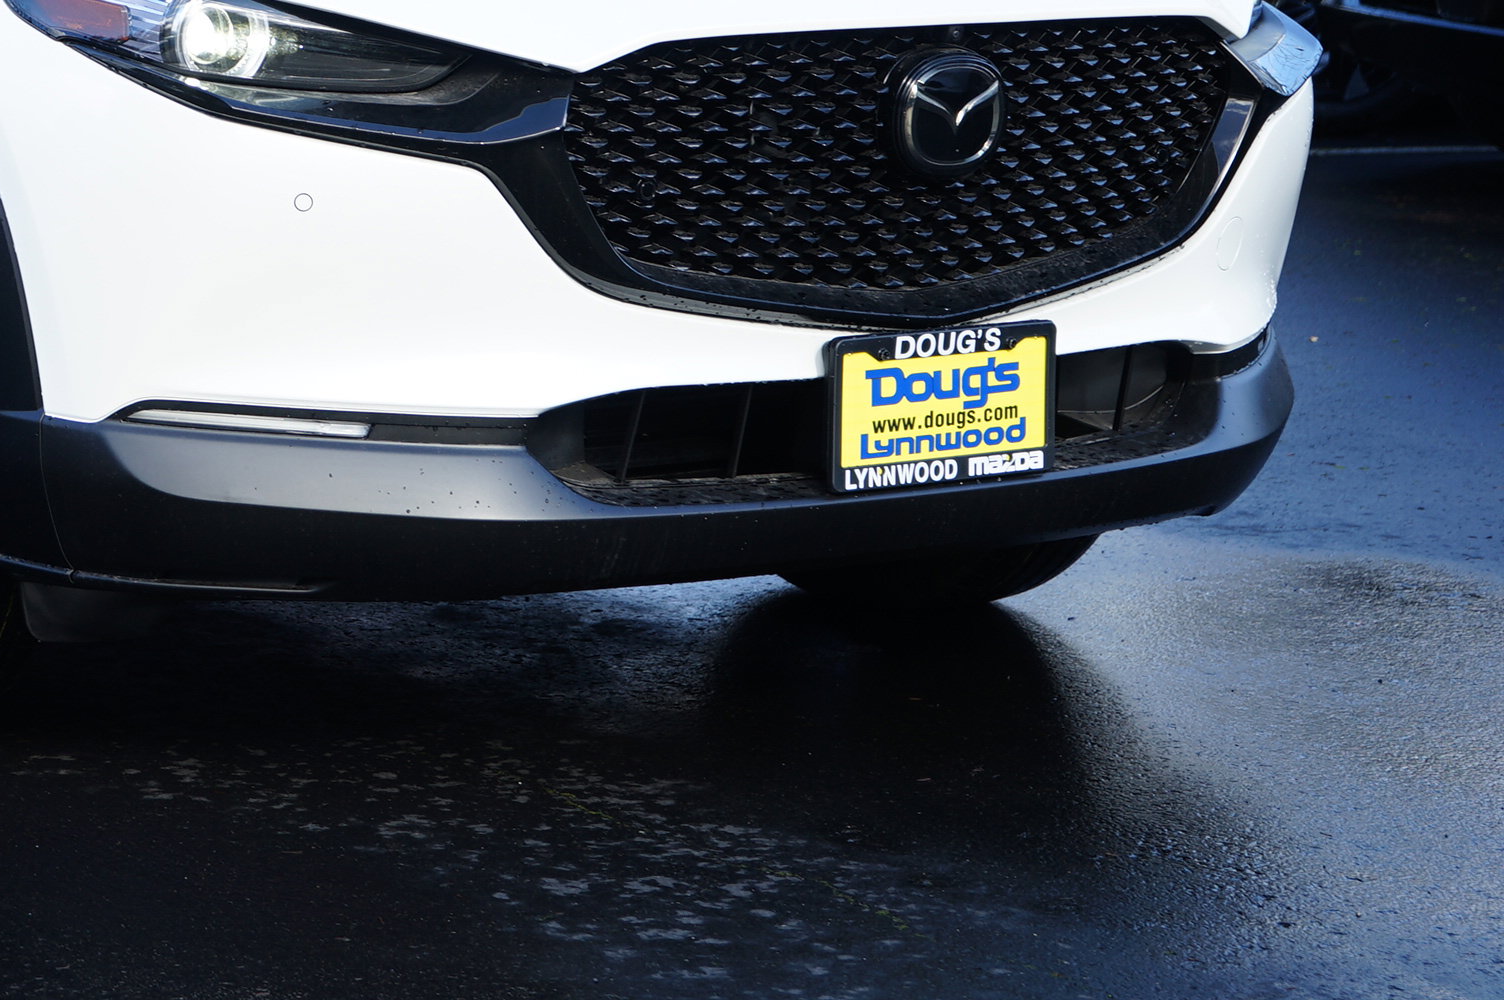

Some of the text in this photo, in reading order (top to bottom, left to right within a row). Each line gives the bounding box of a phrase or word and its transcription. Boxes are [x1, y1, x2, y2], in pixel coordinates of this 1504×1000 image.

[894, 327, 1001, 360] DOUG'S
[865, 357, 1021, 410] Doug's
[872, 404, 1018, 434] www.dougs.com
[860, 416, 1026, 460] Lynnwood
[844, 458, 958, 491] LYNNWOOD
